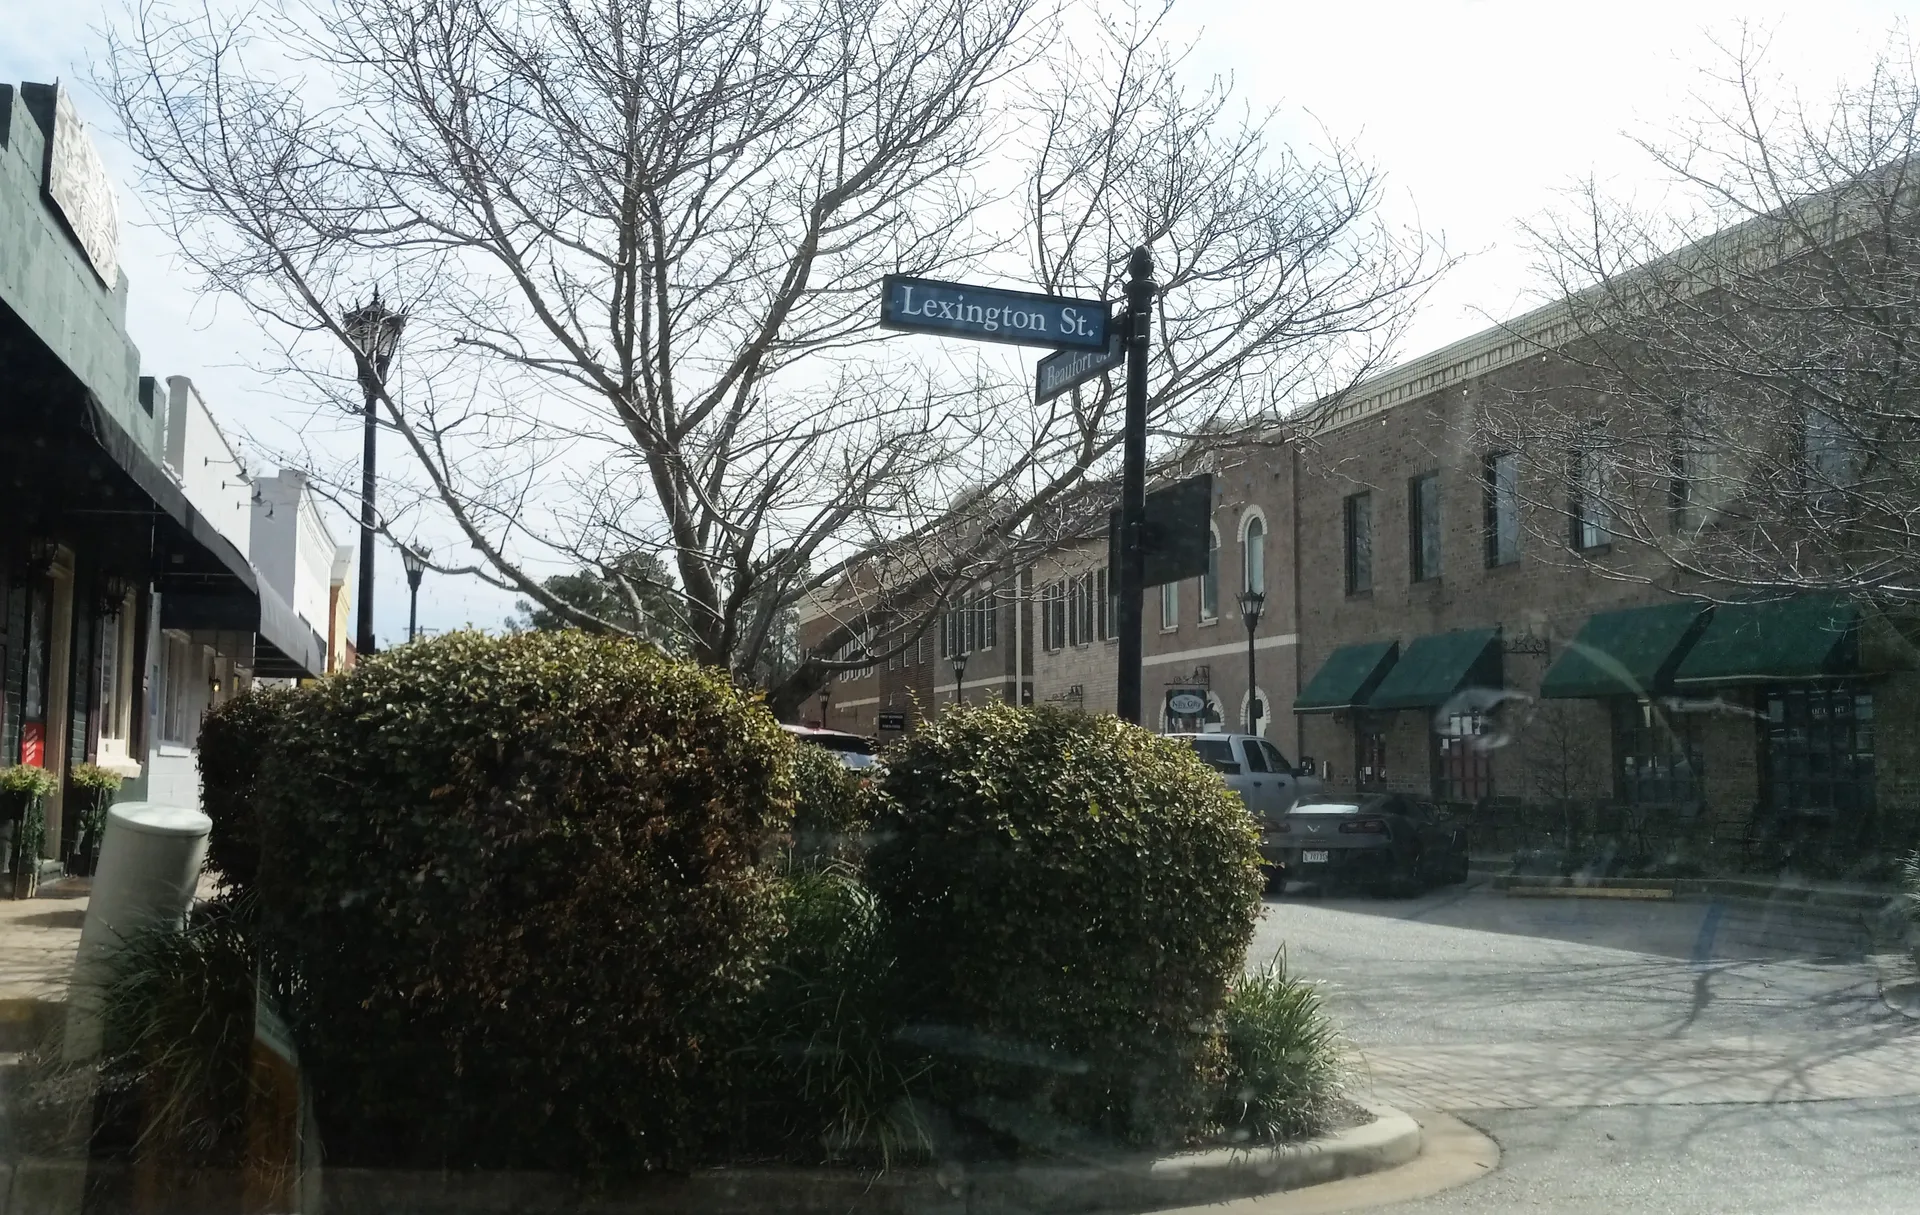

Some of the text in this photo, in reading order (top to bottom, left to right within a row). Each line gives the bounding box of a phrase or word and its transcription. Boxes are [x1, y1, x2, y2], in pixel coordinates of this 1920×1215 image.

[901, 285, 1095, 338] Lexington St.
[1046, 351, 1092, 390] Beaufort
